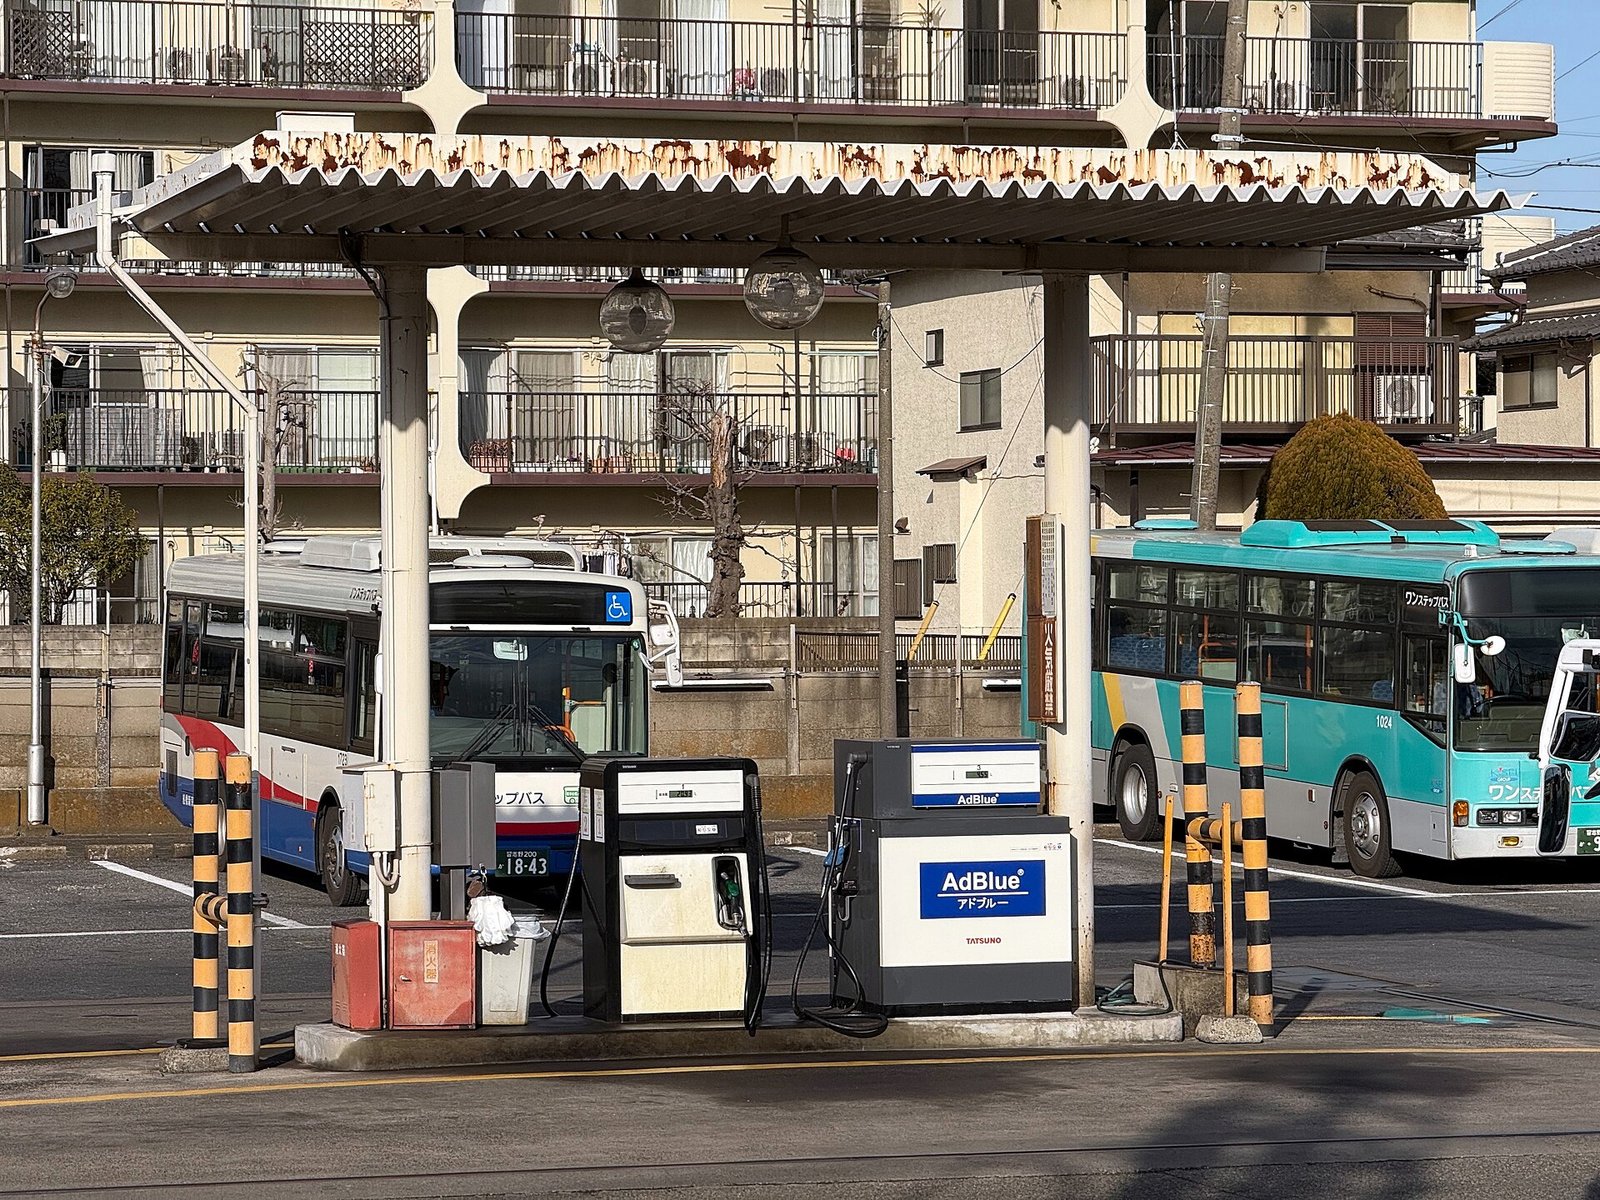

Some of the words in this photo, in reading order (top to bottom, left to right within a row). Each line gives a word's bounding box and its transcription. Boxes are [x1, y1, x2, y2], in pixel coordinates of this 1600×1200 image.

[1405, 591, 1449, 608] ワンステップバス
[1376, 715, 1392, 729] 1024
[507, 858, 547, 875] 18-43
[957, 897, 1009, 910] アドブルー
[966, 937, 1002, 945] TATSUNO
[425, 943, 436, 980] 消火器
